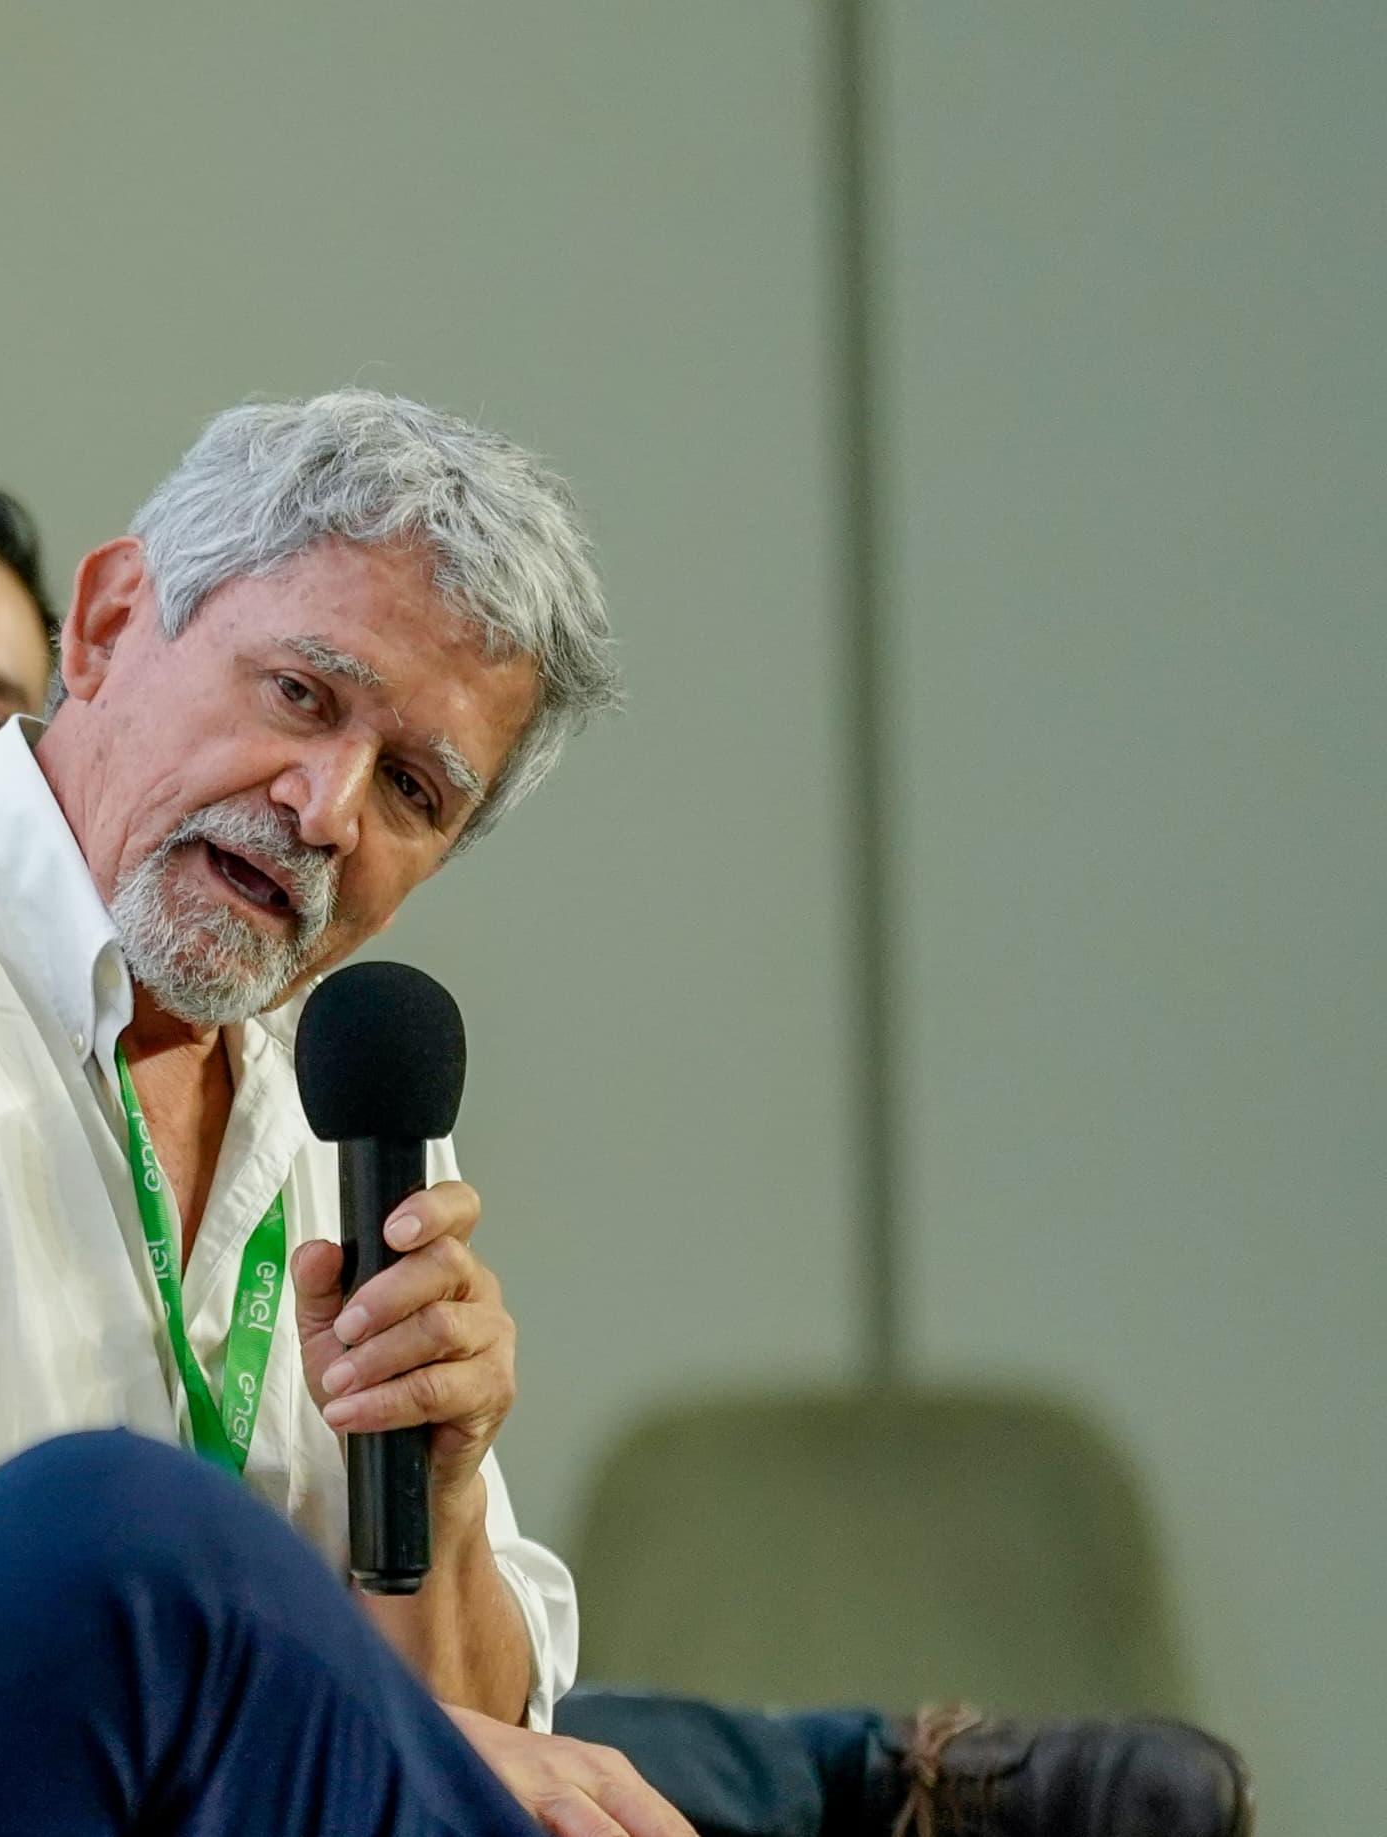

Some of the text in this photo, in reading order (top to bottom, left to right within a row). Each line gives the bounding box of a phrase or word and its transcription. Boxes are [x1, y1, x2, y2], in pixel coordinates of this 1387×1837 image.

[131, 1111, 162, 1193] enel
[248, 1261, 277, 1334] enel
[231, 1372, 256, 1450] enel
